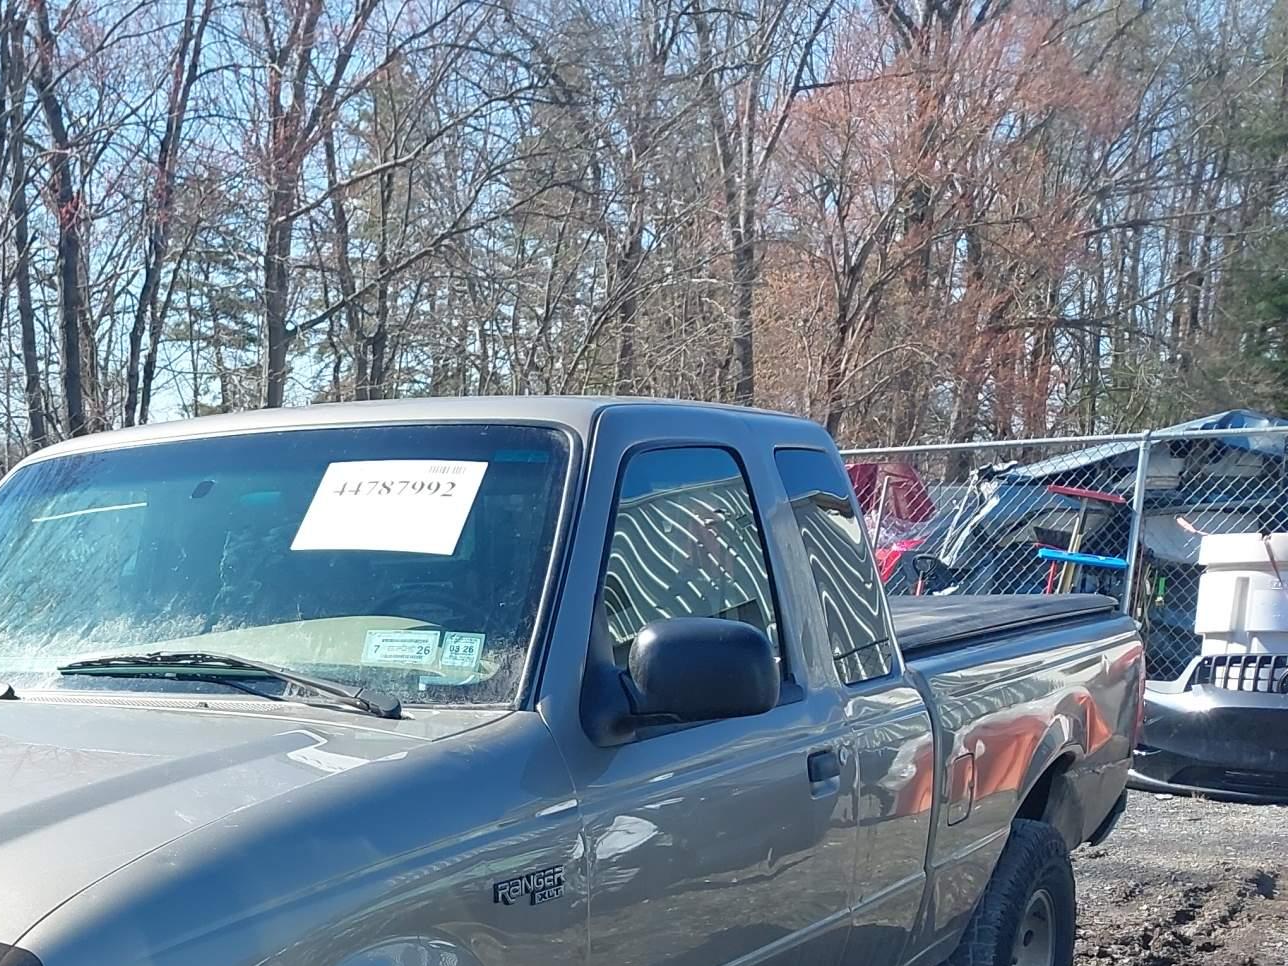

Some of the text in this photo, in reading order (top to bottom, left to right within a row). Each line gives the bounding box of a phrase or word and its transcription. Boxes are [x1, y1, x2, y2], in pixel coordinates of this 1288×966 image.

[333, 480, 457, 497] 44787992
[416, 645, 431, 655] 26
[463, 645, 474, 653] 26
